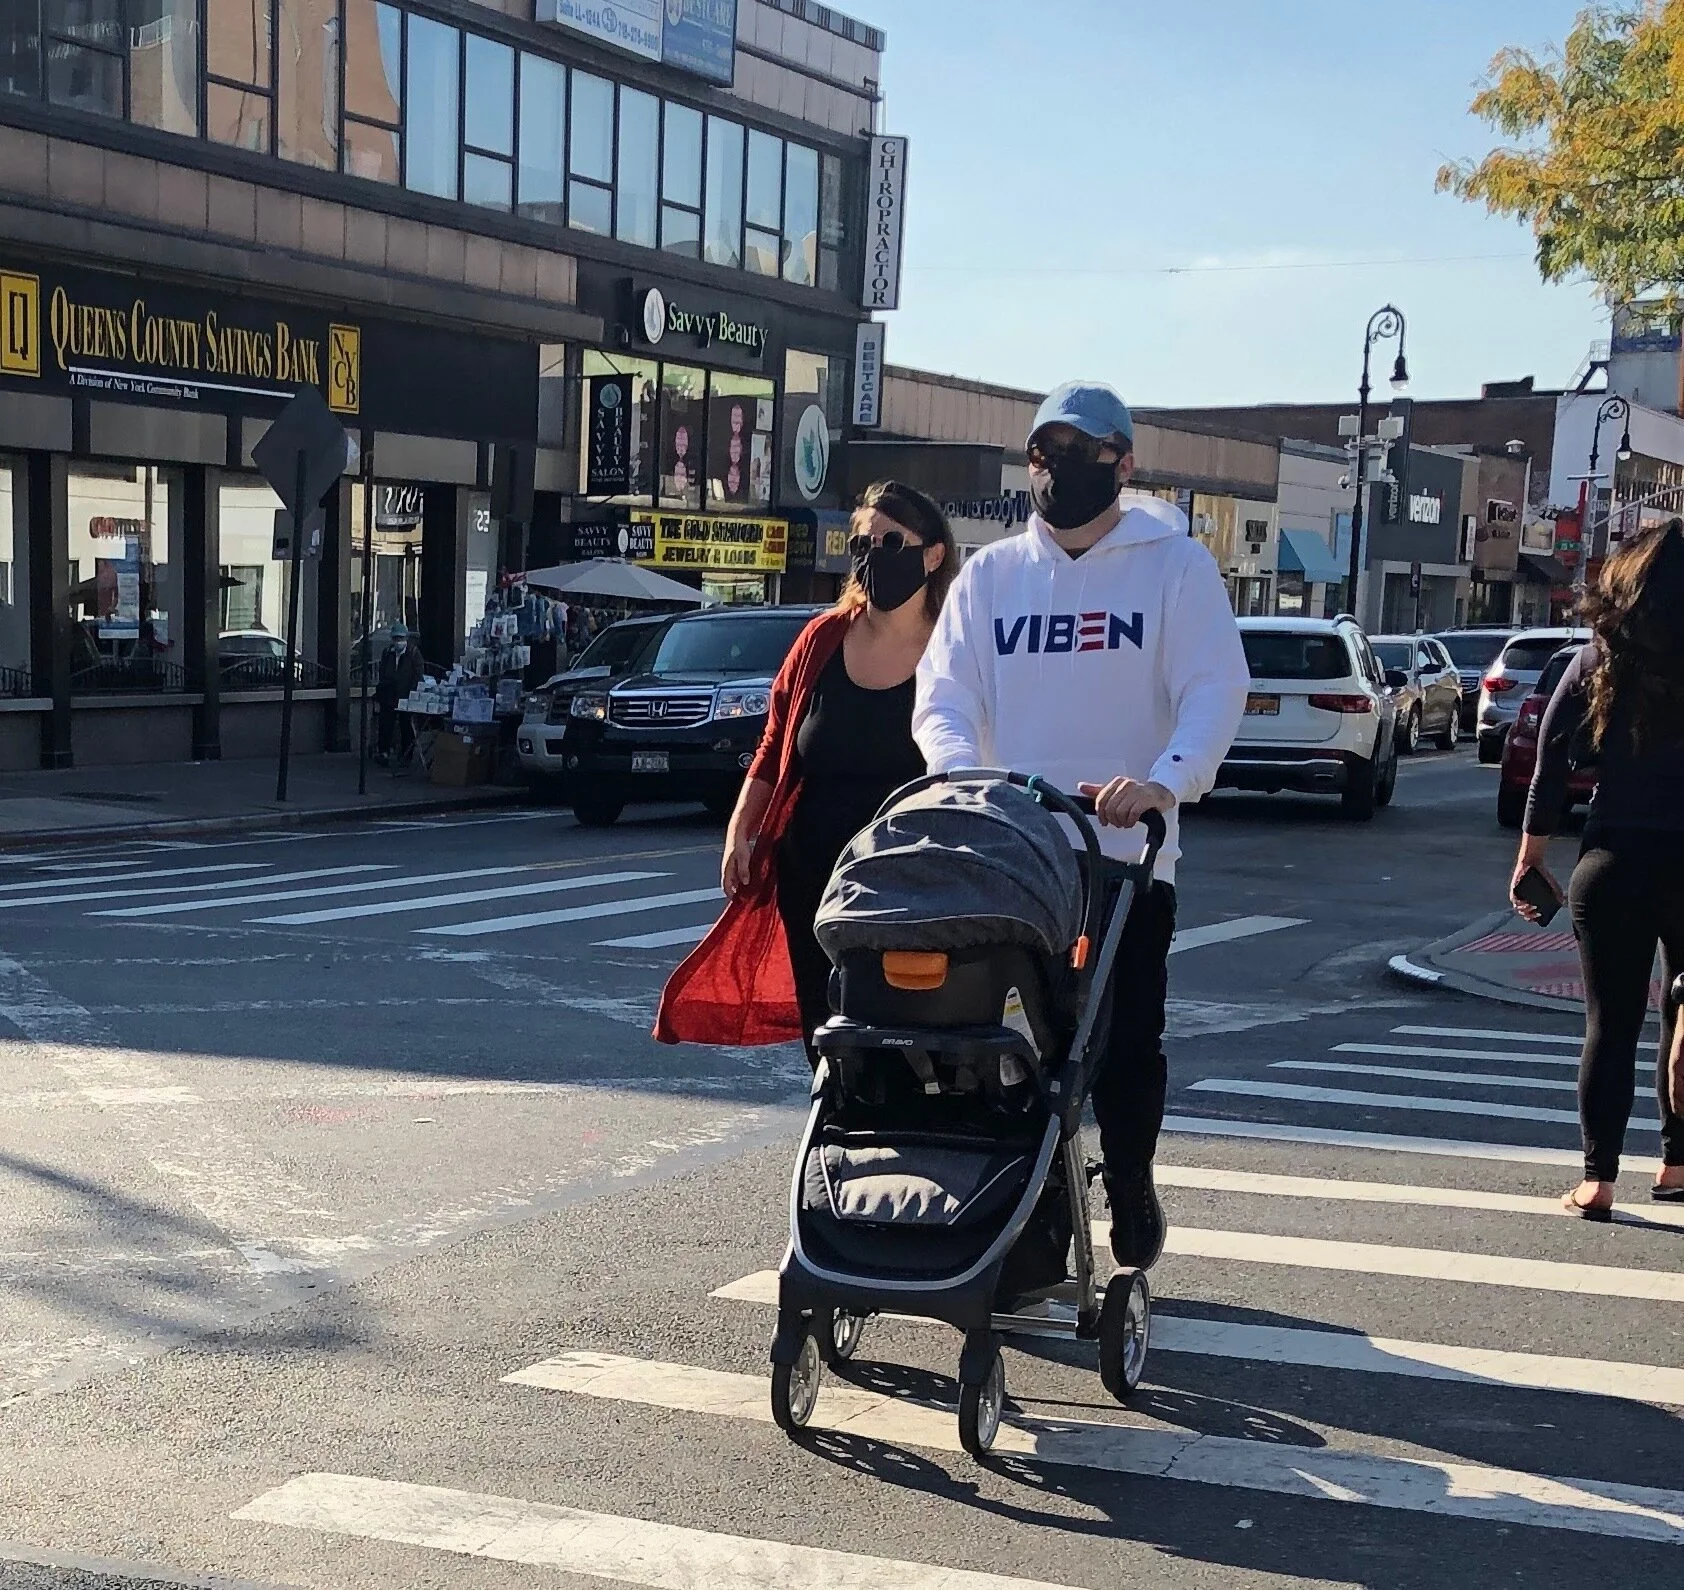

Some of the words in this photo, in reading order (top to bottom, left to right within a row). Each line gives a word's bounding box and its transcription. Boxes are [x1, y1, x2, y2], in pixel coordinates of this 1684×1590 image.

[871, 141, 896, 304] CHIROPRACTOR
[9, 291, 28, 361] Q
[51, 286, 127, 370] QUEENS
[131, 299, 200, 371] COUNTY
[206, 310, 272, 379] SAVINGS
[276, 321, 320, 386] BANK
[668, 301, 716, 348] Savvy
[719, 311, 769, 358] Beauty
[77, 374, 103, 388] Division
[105, 378, 113, 389] of
[113, 378, 128, 391] New
[130, 380, 146, 393] York
[860, 341, 875, 422] BESTCARE
[596, 407, 606, 466] SAVVY
[591, 467, 625, 477] SALON
[1409, 487, 1441, 525] verizon
[577, 525, 608, 535] SAVVY
[631, 525, 652, 537] SAVVY
[660, 517, 682, 539] THE
[684, 518, 711, 541] GOLD
[574, 537, 611, 547] BEAUTY
[629, 537, 653, 550] BEAUTY
[662, 546, 712, 563] JEWELRY
[994, 611, 1144, 656] VIBEN
[881, 1038, 914, 1046] BRAVO
